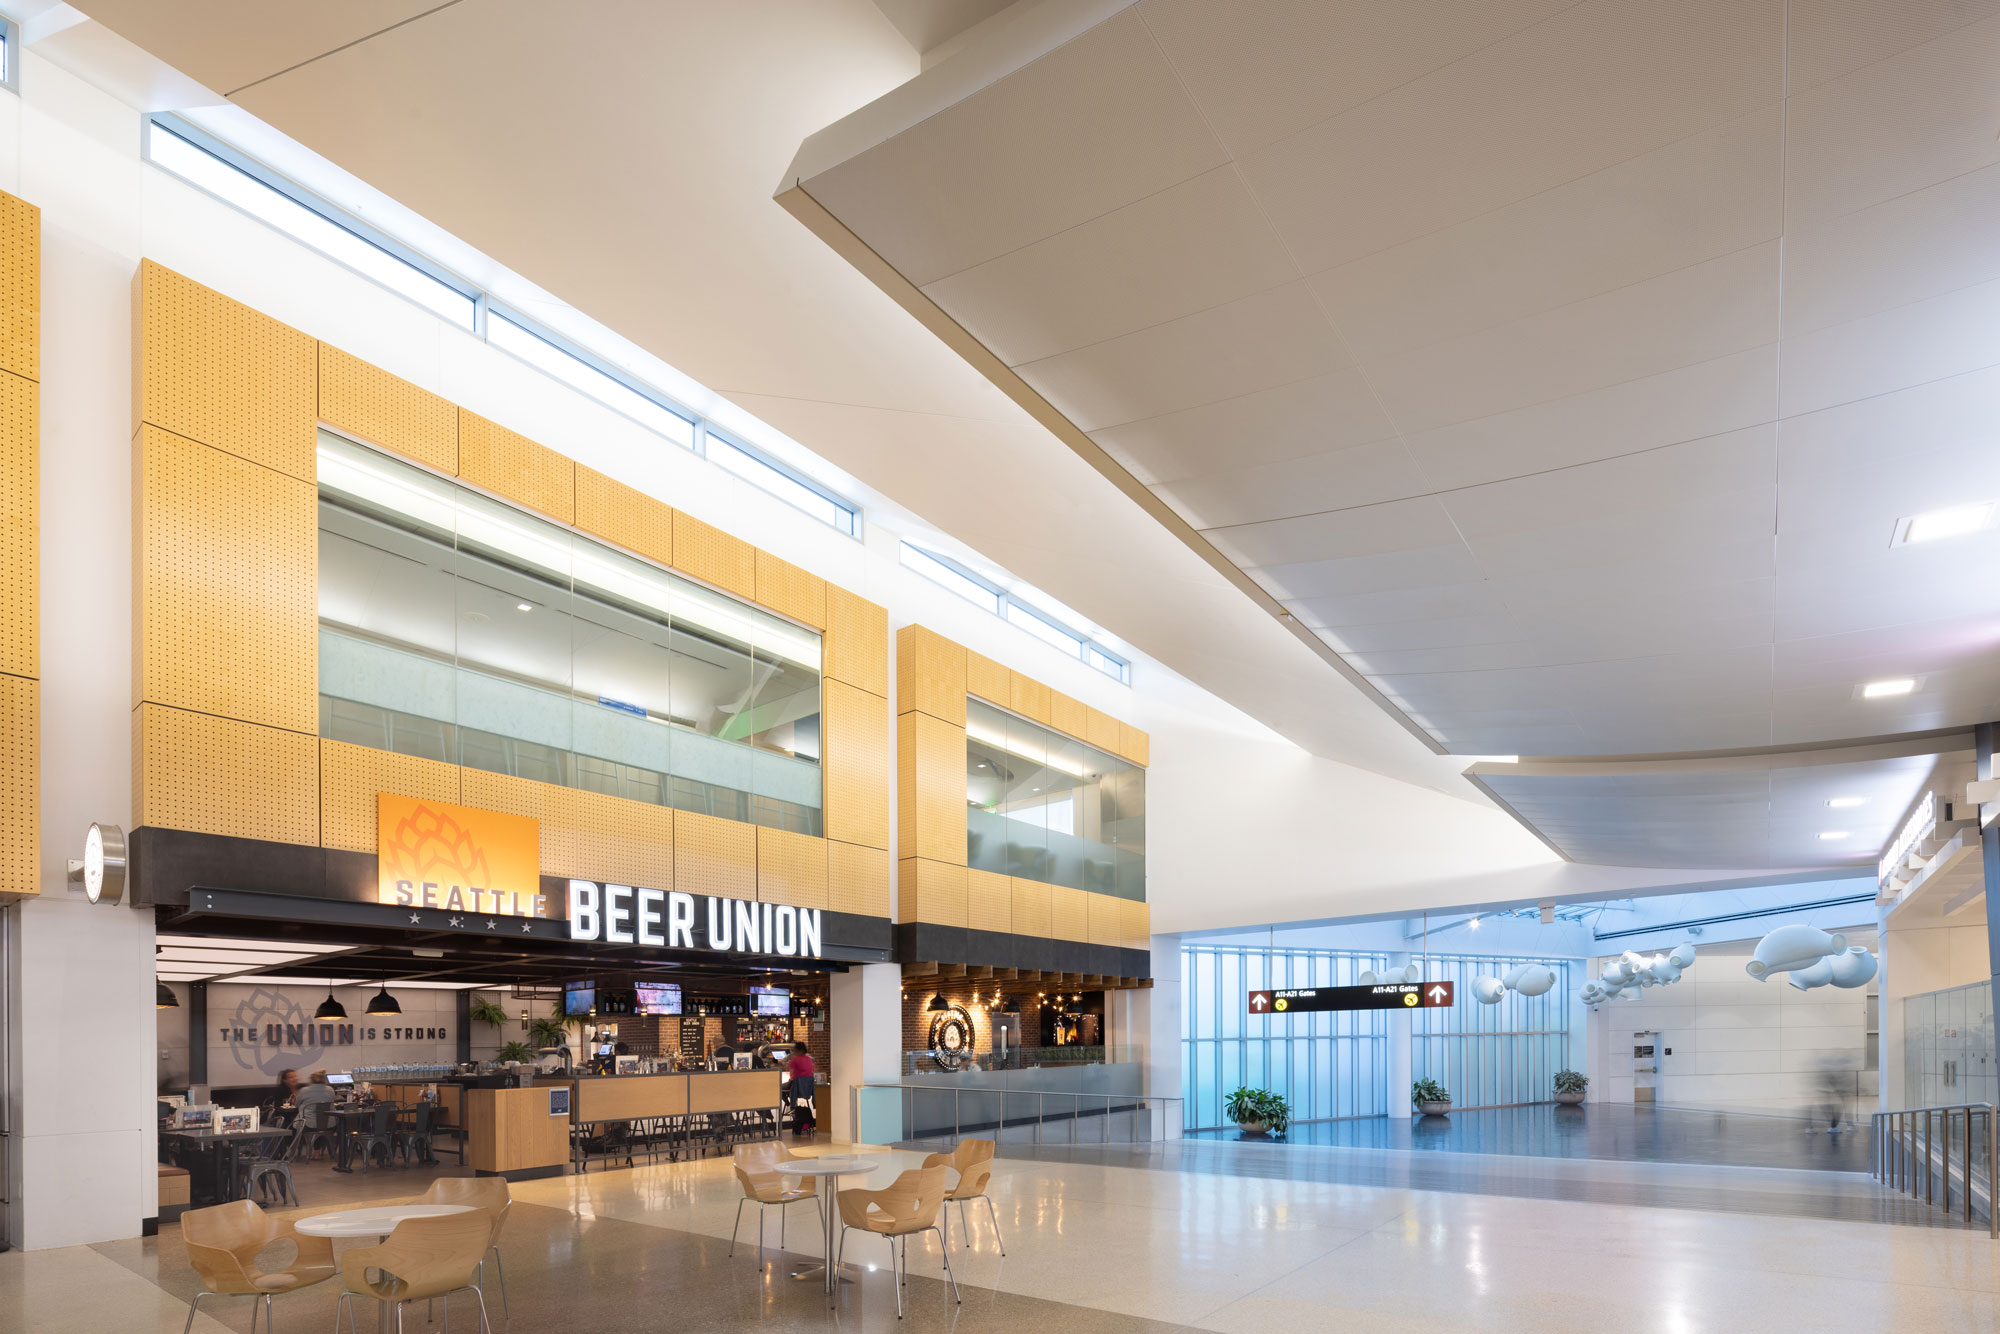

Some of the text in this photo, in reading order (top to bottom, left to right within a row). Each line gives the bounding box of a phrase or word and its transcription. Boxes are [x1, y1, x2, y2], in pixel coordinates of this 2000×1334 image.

[395, 879, 547, 918] SEATTLE
[568, 878, 822, 958] BEER UNION
[1275, 990, 1297, 998] A11-A21
[1372, 985, 1398, 994] A11-A21
[220, 1023, 447, 1046] THE UNION IS STRONG
